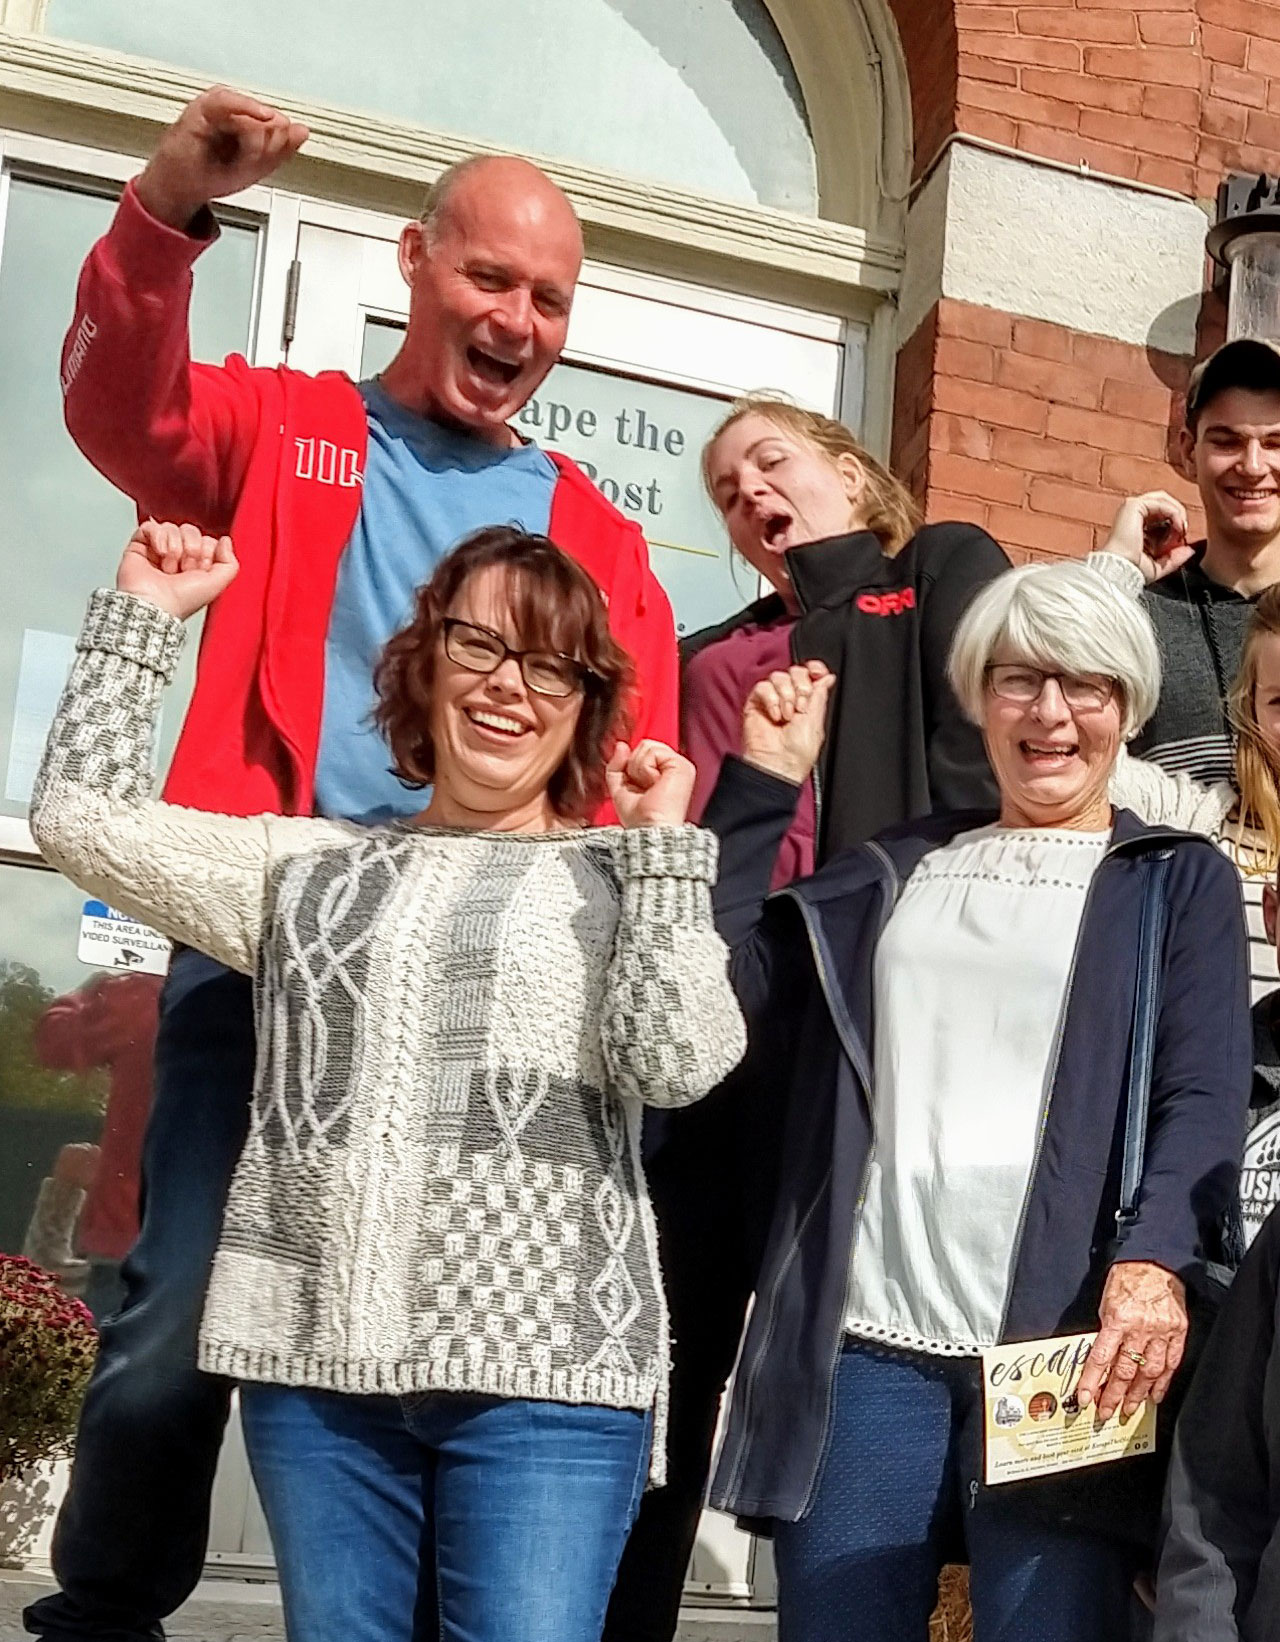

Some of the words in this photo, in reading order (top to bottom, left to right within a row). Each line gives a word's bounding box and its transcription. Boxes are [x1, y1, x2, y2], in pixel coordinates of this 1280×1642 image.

[519, 399, 597, 442] ape
[615, 408, 686, 457] the
[93, 920, 113, 931] THIS
[115, 924, 141, 935] AREA
[82, 930, 110, 943] VIDEO
